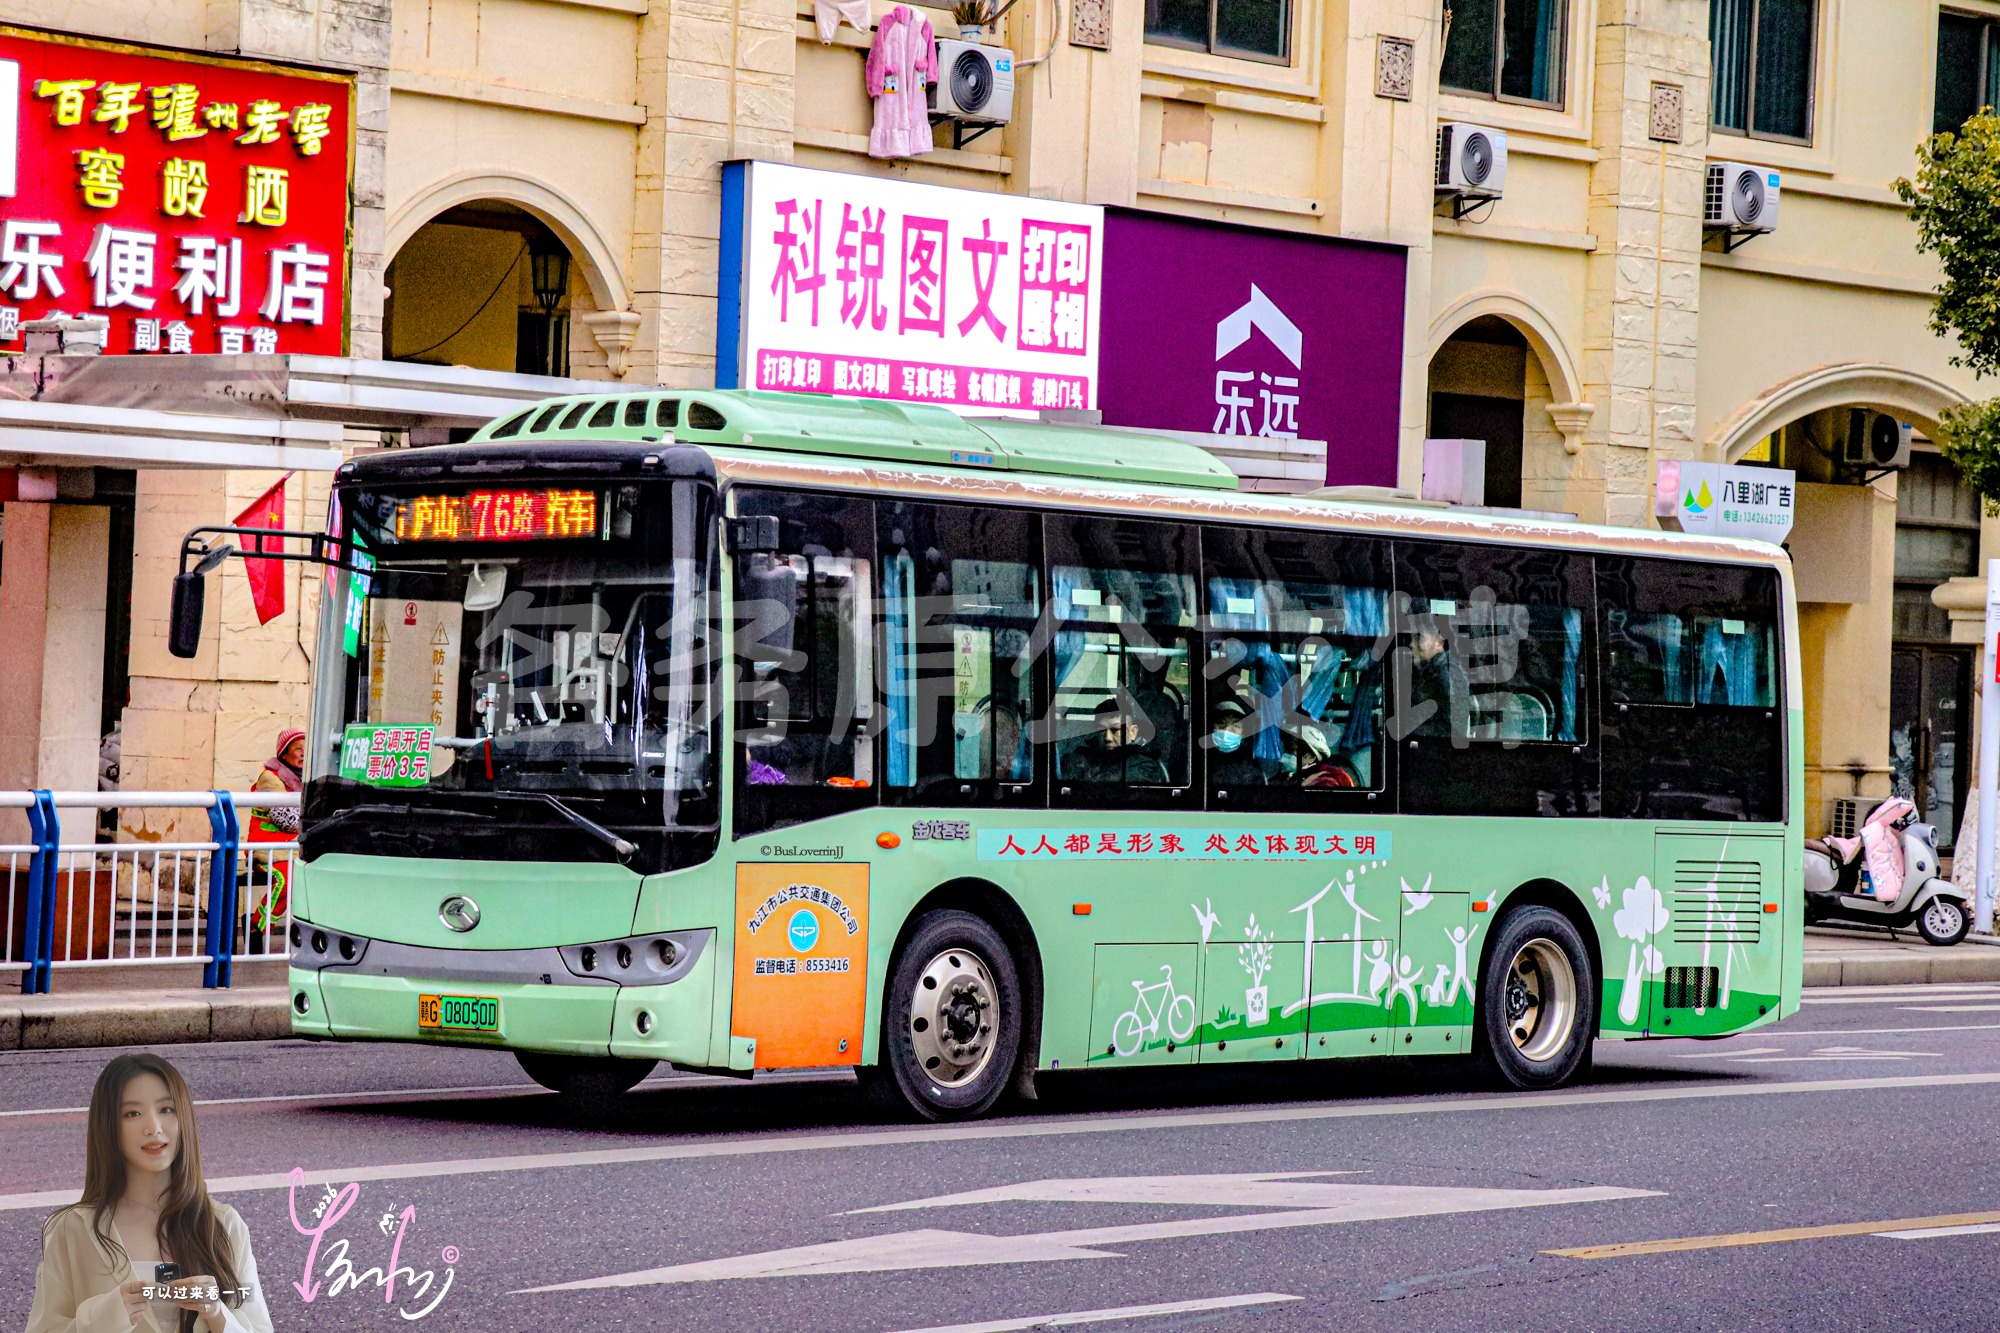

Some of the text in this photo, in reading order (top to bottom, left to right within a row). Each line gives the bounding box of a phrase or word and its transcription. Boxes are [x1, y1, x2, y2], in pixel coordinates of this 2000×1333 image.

[78, 148, 289, 226] 窖龄酒
[0, 220, 330, 326] 乐便利店
[771, 198, 1008, 343] 科锐图文
[1024, 226, 1087, 286] 打印
[135, 318, 193, 354] 副食
[220, 325, 279, 354] 百货
[763, 354, 821, 387] 打印复印
[1213, 371, 1299, 438] 乐远
[1723, 481, 1791, 507] 八里湖广告
[430, 649, 445, 727] 防止夹伤
[371, 729, 432, 752] 空调开启
[912, 819, 970, 840] 金龙客车
[998, 833, 1377, 856] 人人都是形象 处处体现文明
[748, 884, 859, 935] 九江市公共交通集团公司
